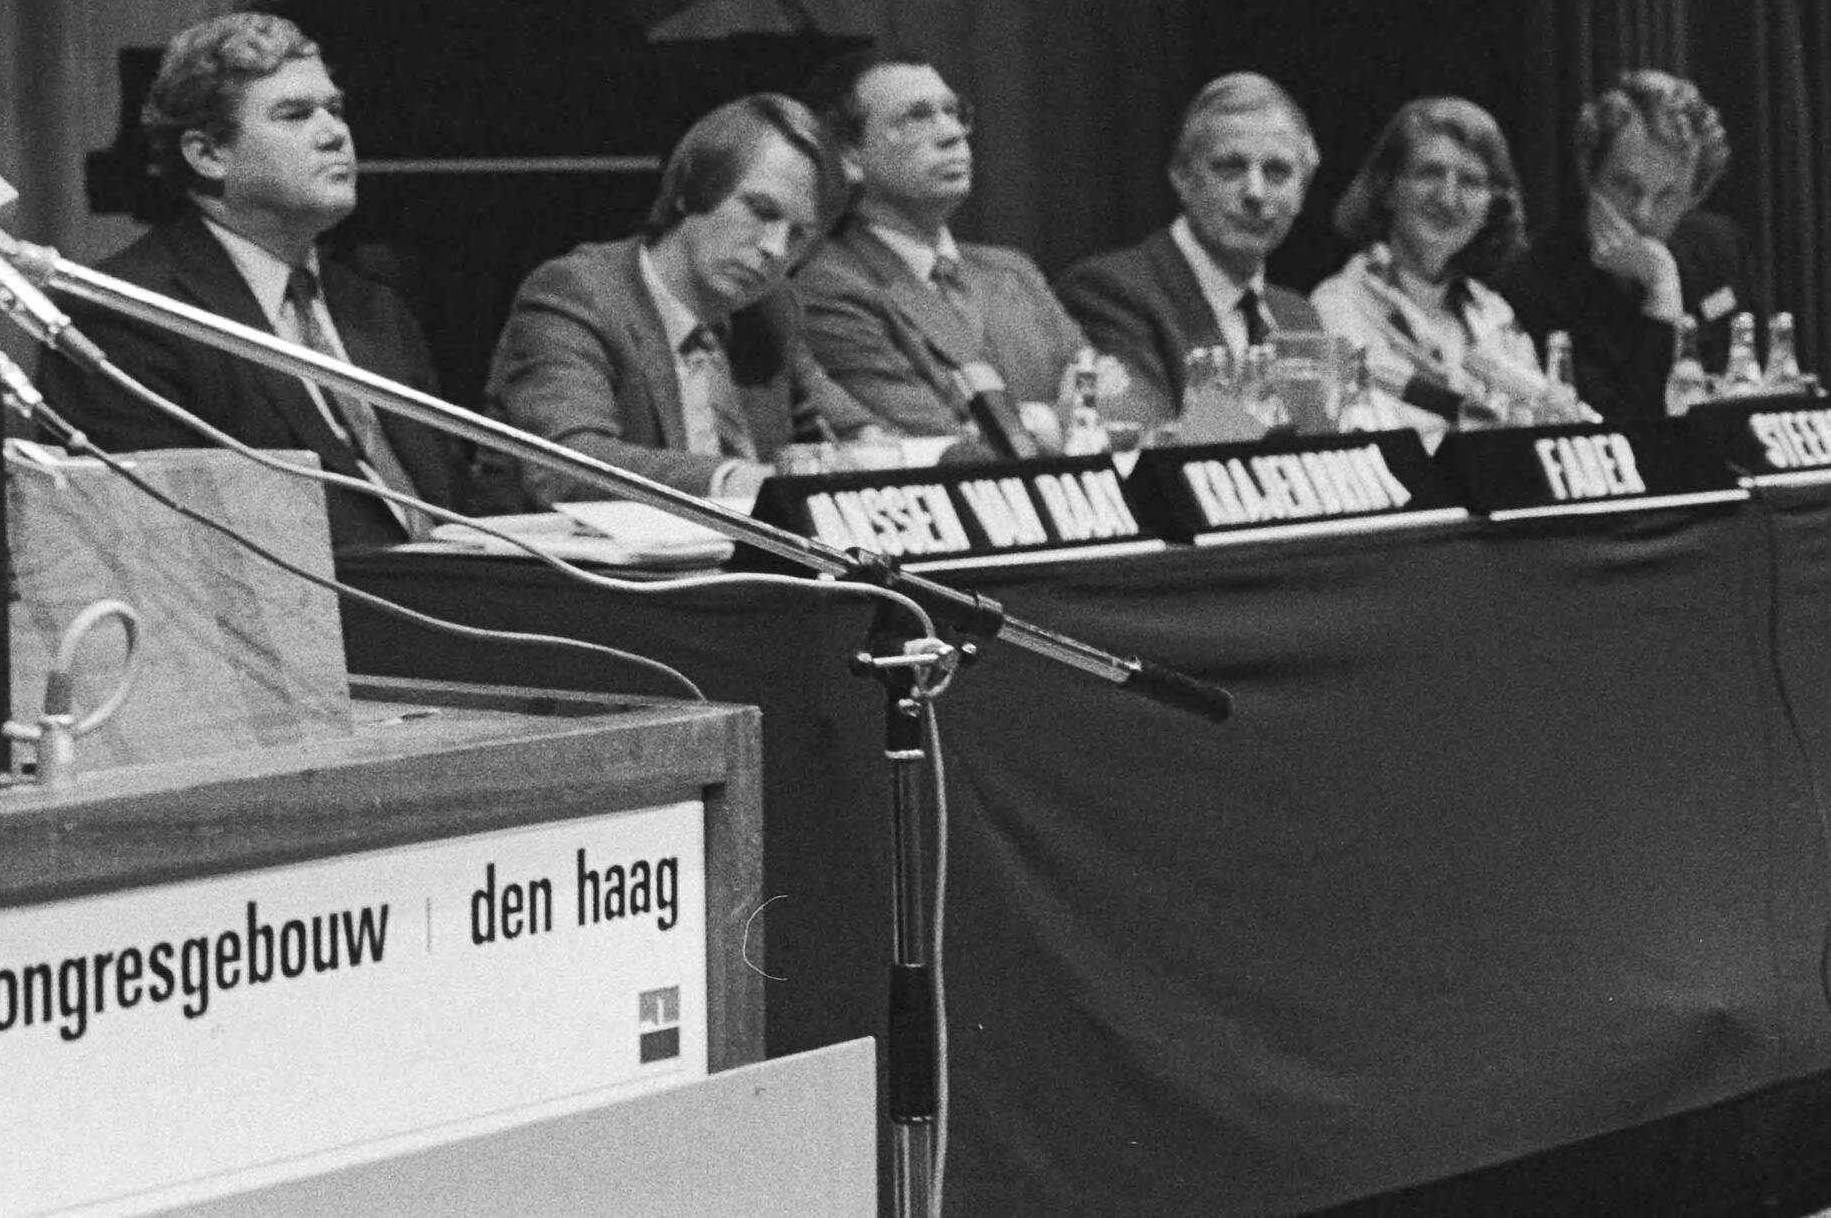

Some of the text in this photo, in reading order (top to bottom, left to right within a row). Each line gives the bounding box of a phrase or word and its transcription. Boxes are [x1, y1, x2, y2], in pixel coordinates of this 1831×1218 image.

[959, 478, 1047, 548] VAN
[470, 862, 553, 946] den
[576, 847, 679, 932] haag
